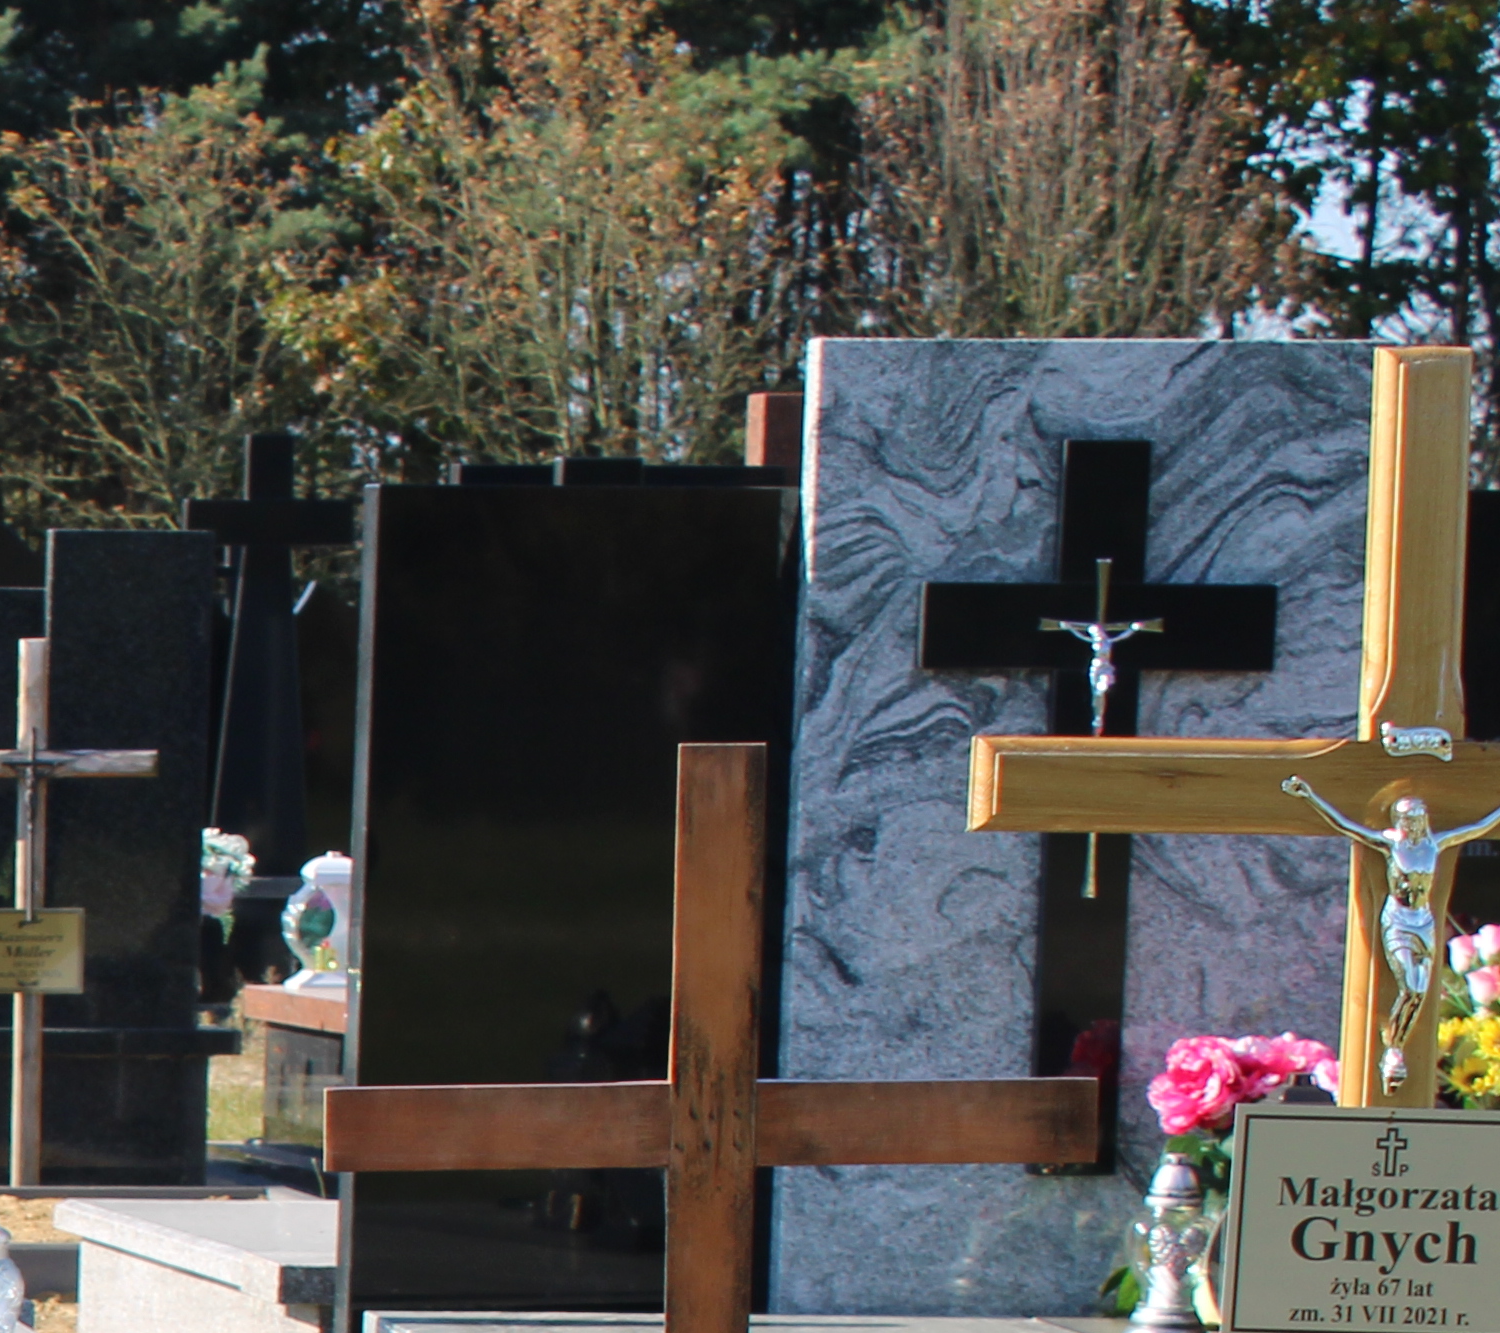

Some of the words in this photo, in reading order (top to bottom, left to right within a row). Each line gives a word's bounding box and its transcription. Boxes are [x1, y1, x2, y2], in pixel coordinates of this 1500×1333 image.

[1276, 1176, 1500, 1217] Małgorzata
[1291, 1215, 1478, 1276] Gnych
[1329, 1277, 1370, 1300] żyła
[1377, 1278, 1401, 1297] 67
[1407, 1279, 1434, 1298] lat
[1288, 1306, 1325, 1323] zm.
[1330, 1306, 1353, 1323] 31
[1362, 1306, 1397, 1324] VII
[1402, 1307, 1448, 1326] 2021
[1456, 1312, 1470, 1326] r.
